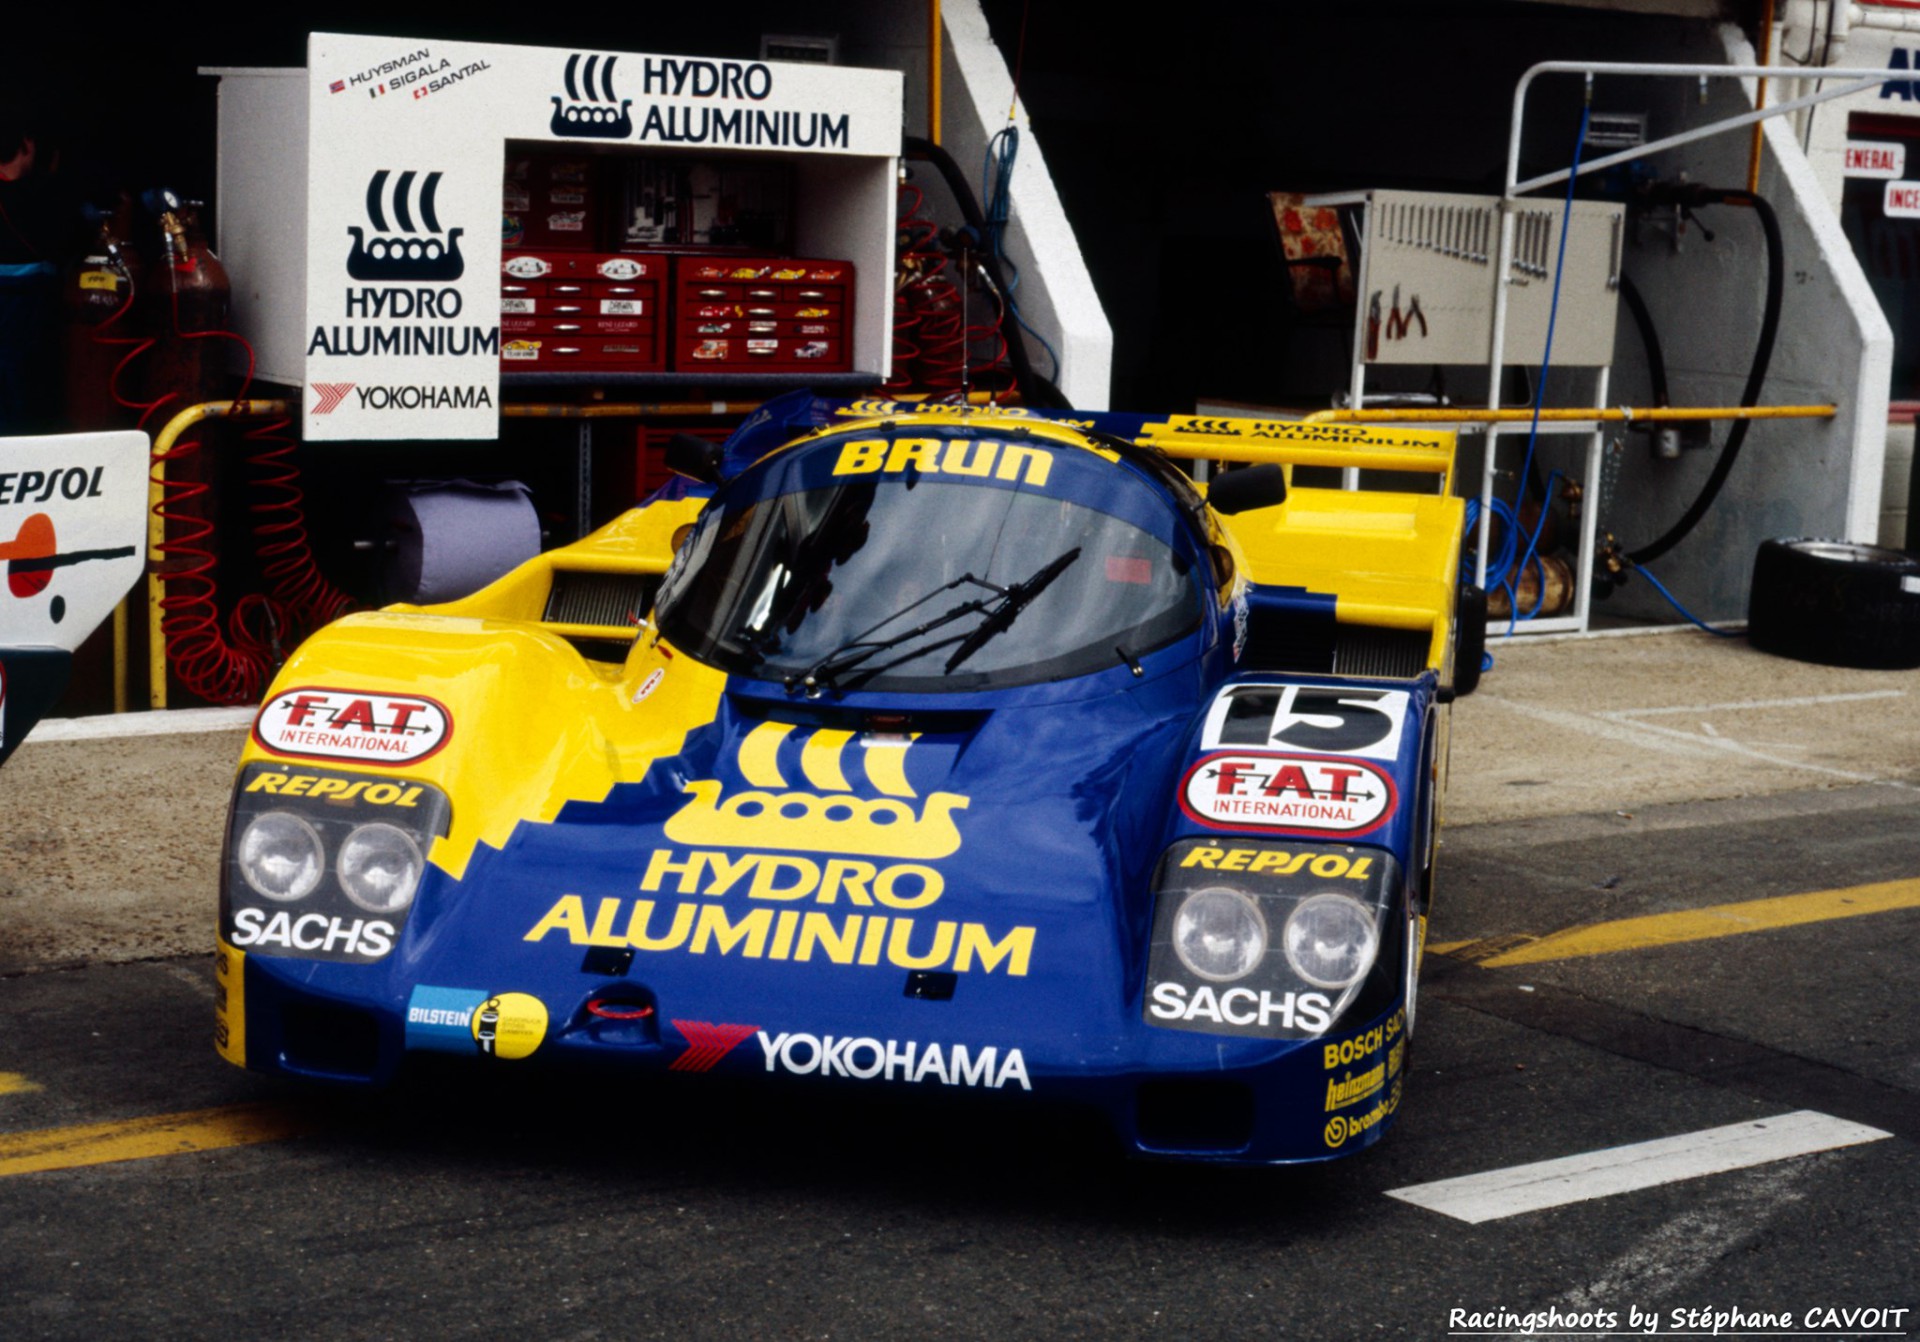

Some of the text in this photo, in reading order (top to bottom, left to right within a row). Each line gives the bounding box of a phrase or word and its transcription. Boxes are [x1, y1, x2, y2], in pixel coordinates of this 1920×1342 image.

[349, 48, 430, 86] HUYSMAN
[389, 58, 451, 90] SIGALA
[428, 60, 491, 92] SANTAL
[643, 58, 772, 101] HYDRO
[639, 104, 849, 148] ALUMINIUM
[346, 287, 462, 318] HYDRO
[307, 326, 499, 356] ALUMINIUM
[356, 386, 492, 409] YOKOHAMA
[1250, 431, 1440, 448] ALUMINIUM
[1253, 422, 1367, 436] HYDRO
[1220, 685, 1394, 752] 15
[279, 730, 409, 754] INTERNATIONAL
[245, 772, 424, 808] REPSOL
[1213, 800, 1356, 822] INTERNATIONAL
[639, 849, 945, 909] HYDRO
[1180, 847, 1373, 880] REPSOL
[231, 908, 396, 957] SACHS
[523, 894, 1037, 976] ALUMINIUM
[408, 1007, 471, 1027] BILSTEIN
[1150, 982, 1332, 1033] SACHS
[757, 1031, 1032, 1090] YOKOHAMA
[1324, 1025, 1383, 1070] BOSCH
[1349, 1099, 1389, 1137] brembo
